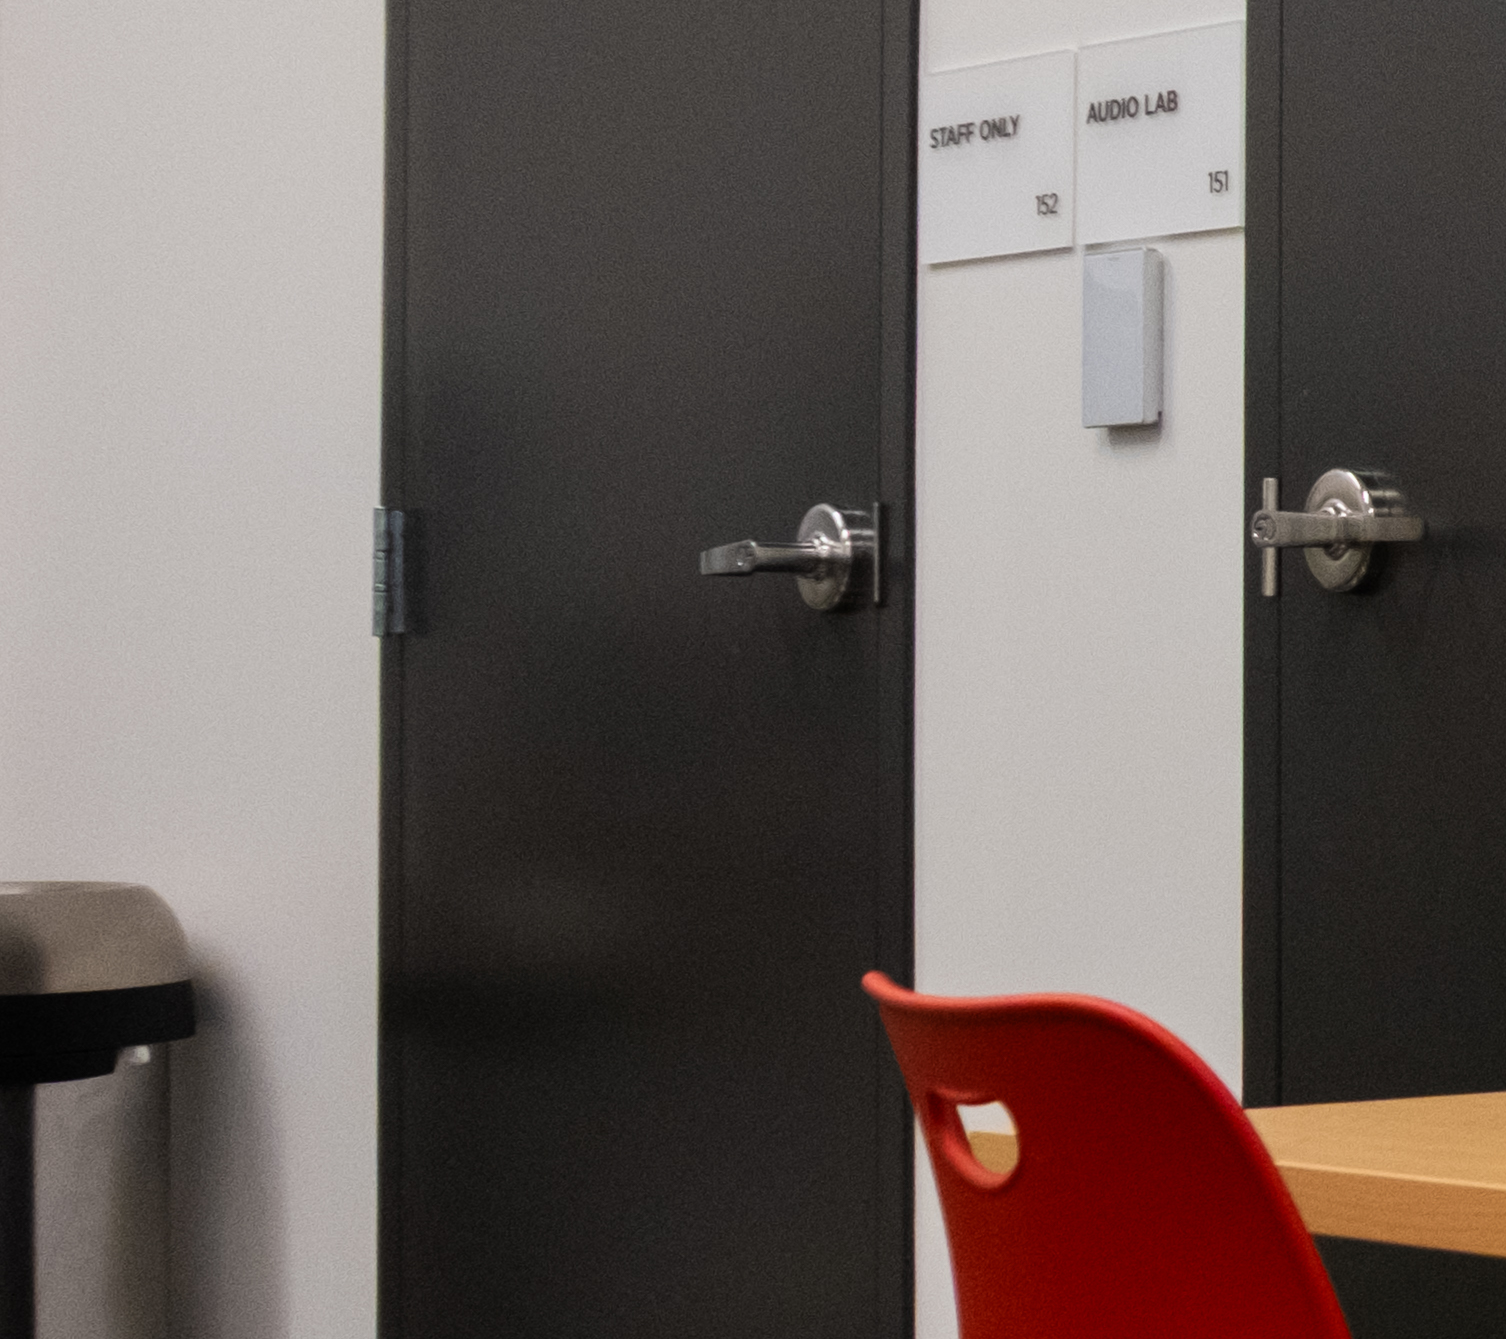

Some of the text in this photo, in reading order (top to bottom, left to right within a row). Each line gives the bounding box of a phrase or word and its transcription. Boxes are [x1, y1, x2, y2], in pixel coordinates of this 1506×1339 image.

[1086, 89, 1179, 124] AUDIO LAB
[929, 114, 1021, 149] STAFF ONLY
[1208, 169, 1229, 193] 151
[1035, 192, 1059, 216] 152
